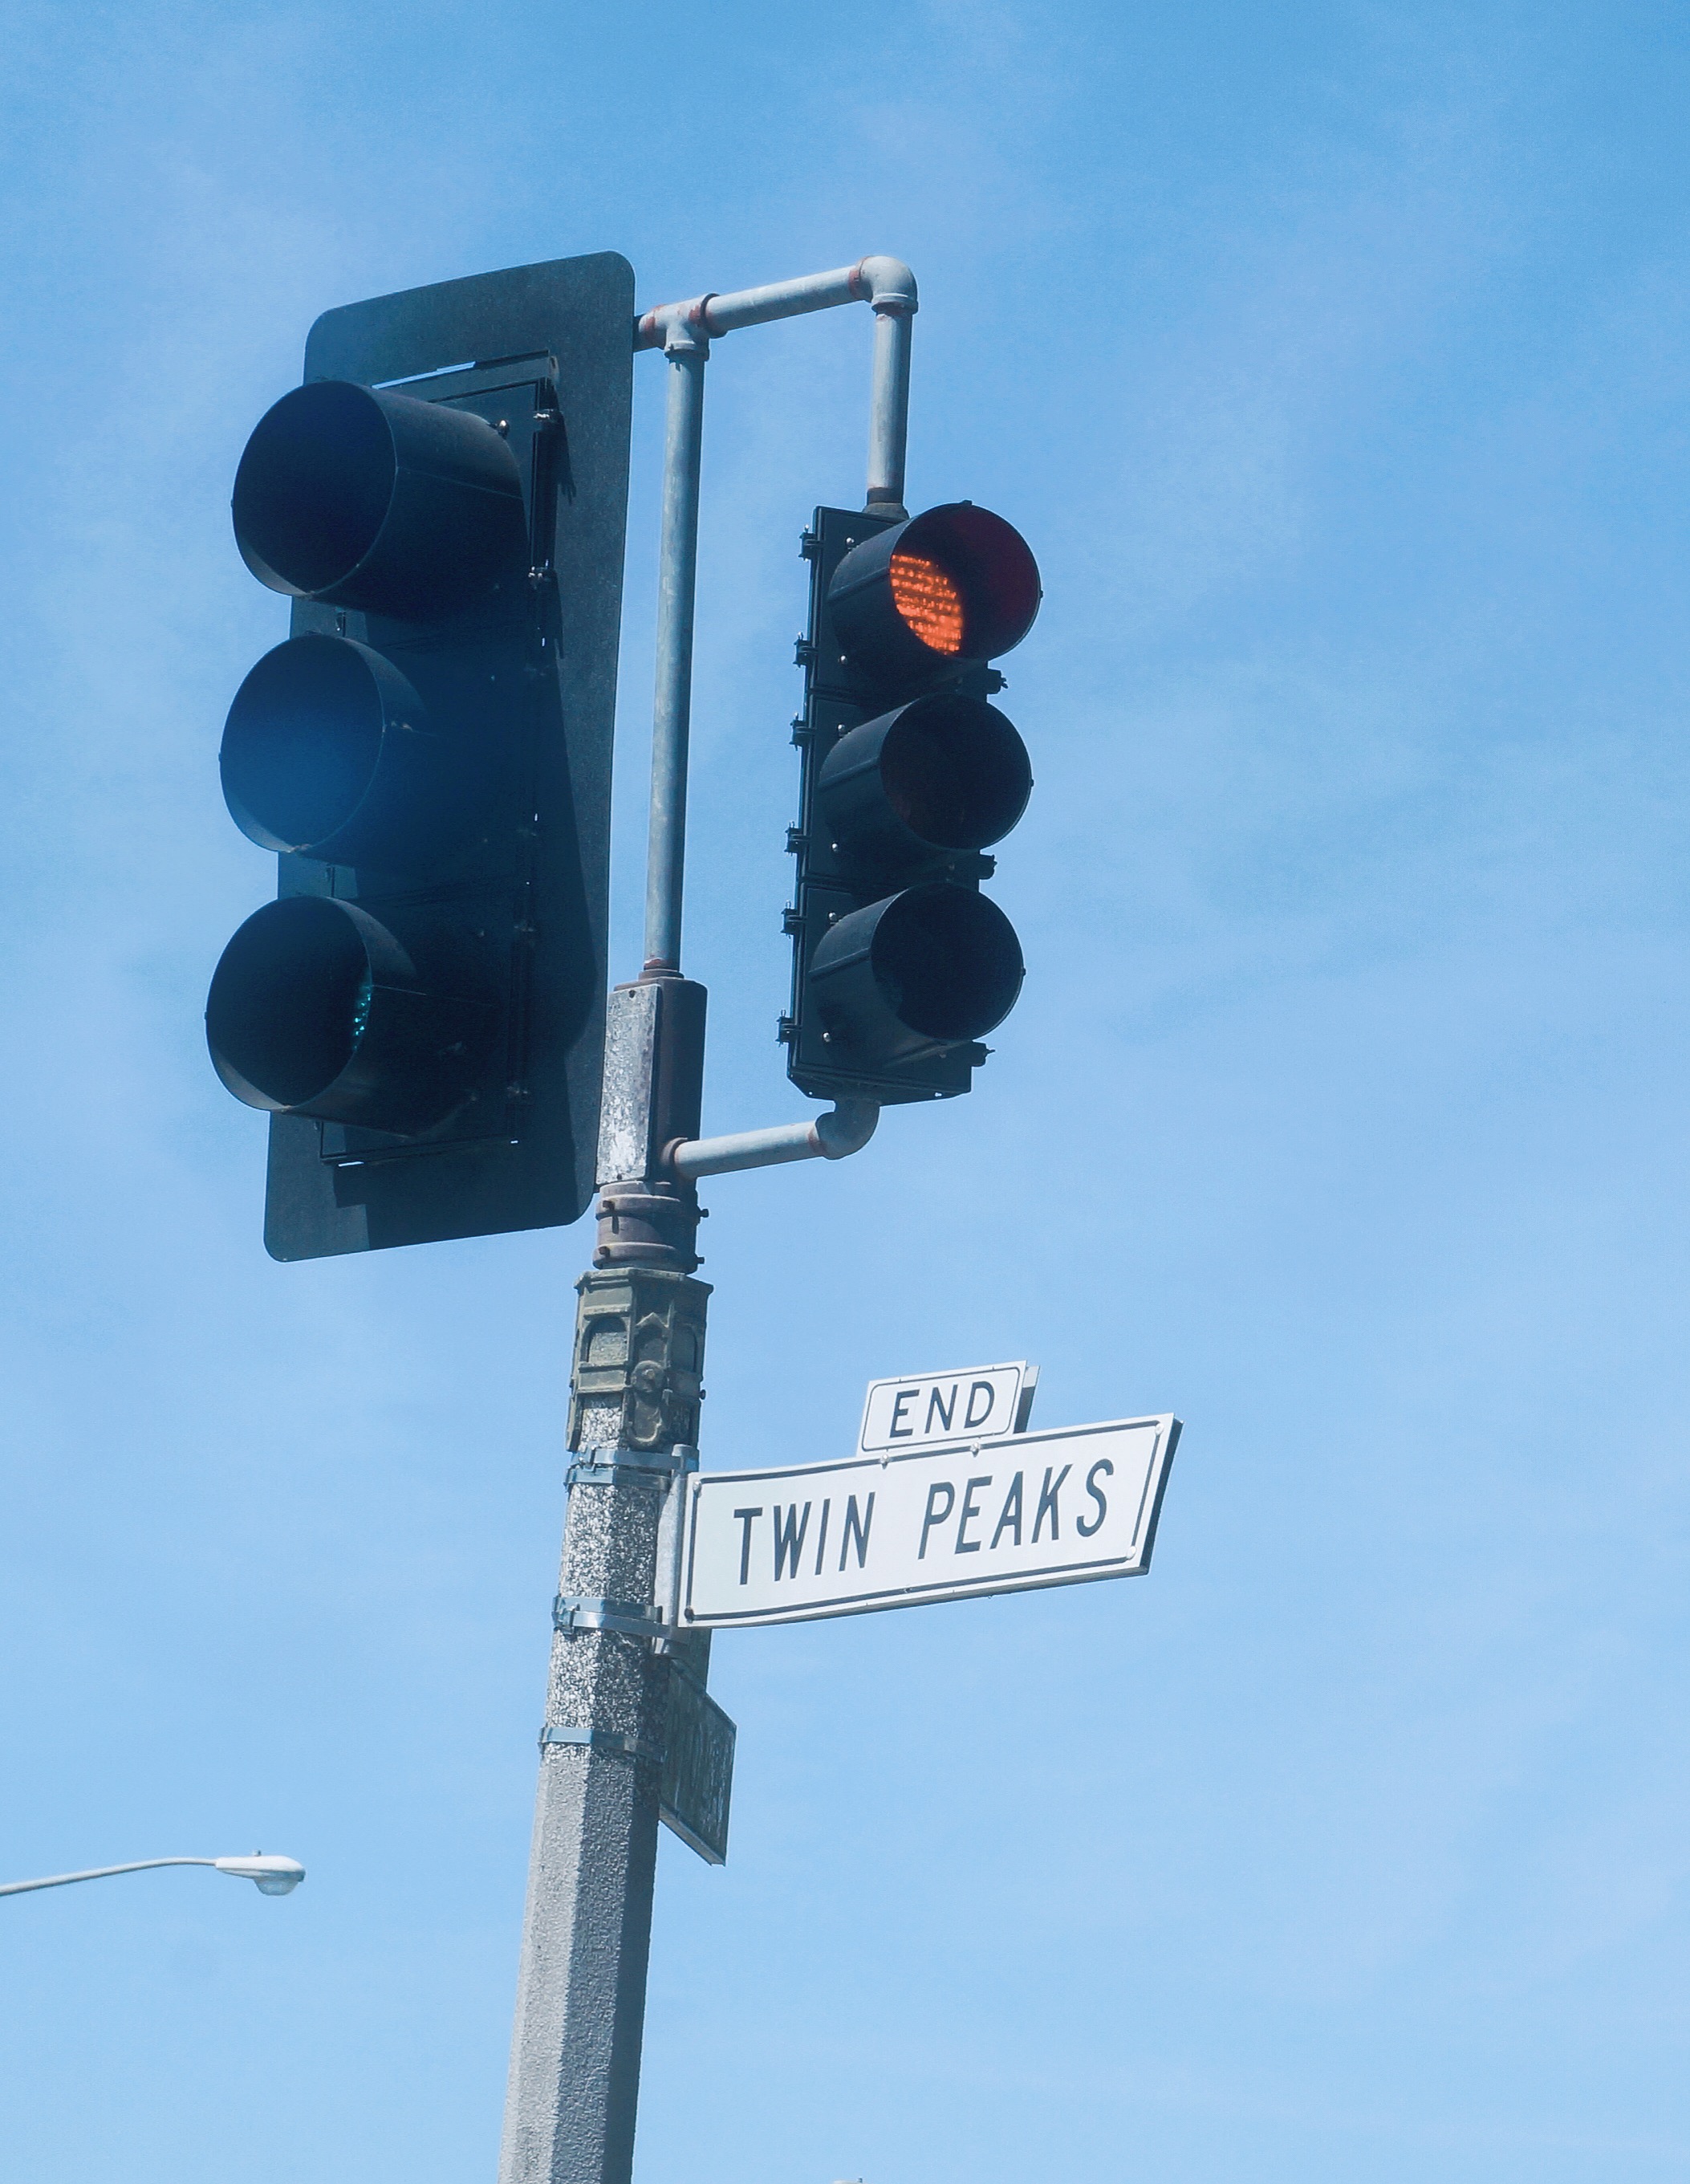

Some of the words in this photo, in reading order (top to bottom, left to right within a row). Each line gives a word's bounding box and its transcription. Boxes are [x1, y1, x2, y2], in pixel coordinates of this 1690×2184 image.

[888, 1380, 995, 1439] END
[733, 1491, 875, 1585] TWIN
[917, 1458, 1115, 1560] PEAKS
